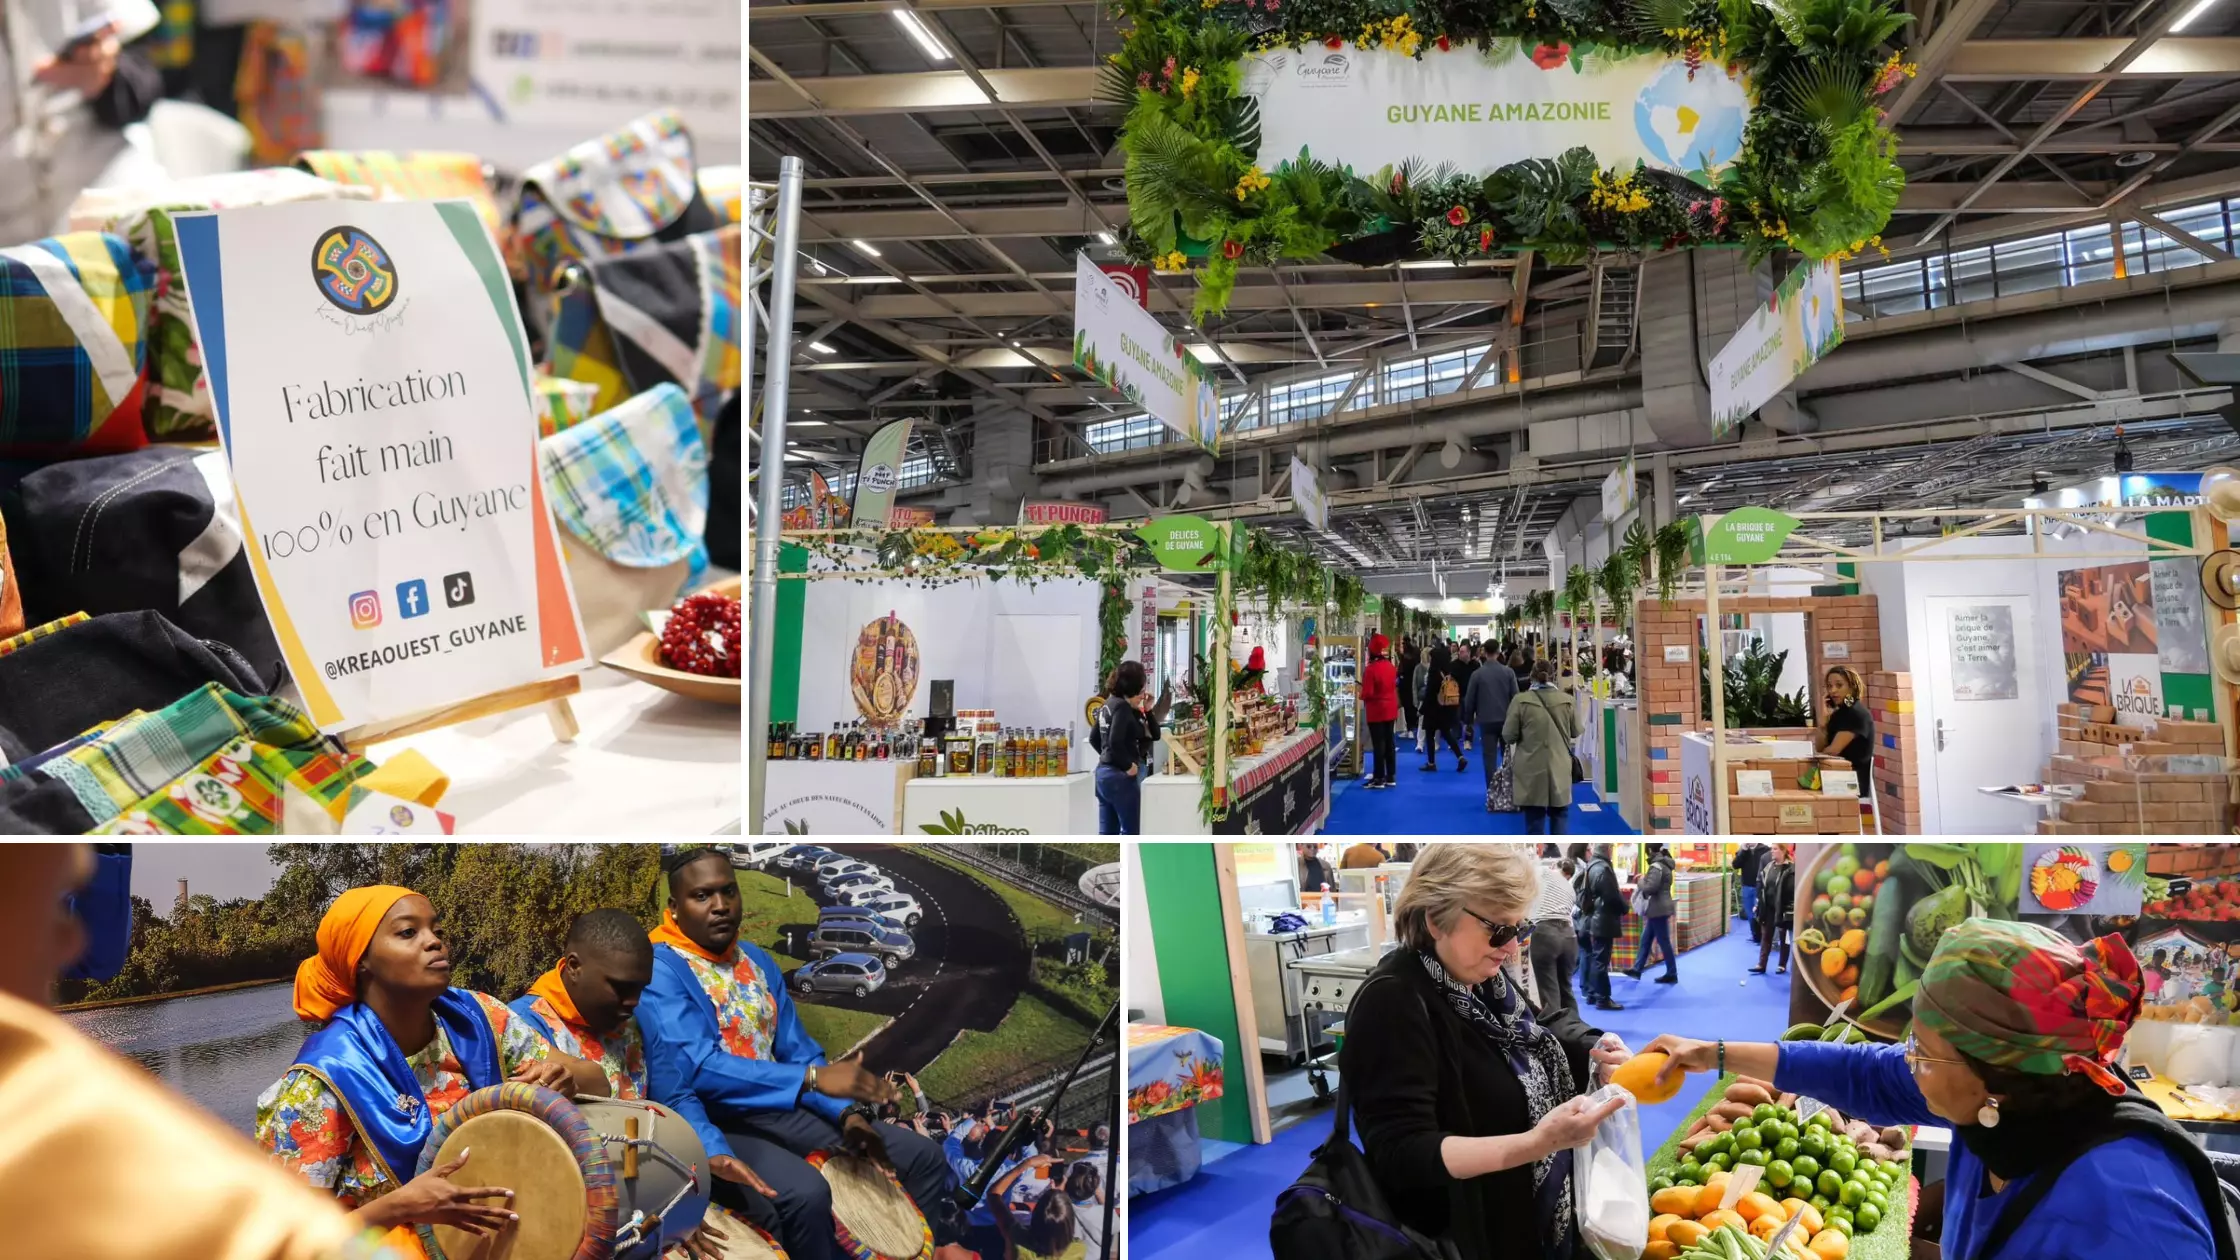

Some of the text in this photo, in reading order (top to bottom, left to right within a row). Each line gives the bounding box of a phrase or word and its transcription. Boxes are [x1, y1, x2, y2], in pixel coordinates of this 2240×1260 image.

[1387, 101, 1612, 124] GUYANE AMAZONIE
[1120, 332, 1185, 397] GUYANE AMAZONIE
[1730, 327, 1783, 390] GUYANE AMAZONIE
[282, 369, 467, 423] Fabrication
[316, 430, 453, 483] fait main
[263, 484, 528, 561] 100% en Guyane
[1725, 522, 1775, 532] LA BRIQUE DE
[1170, 530, 1199, 540] DELICES
[1736, 533, 1764, 543] GUYANE
[1165, 540, 1204, 551] DE GUYANE
[1955, 614, 1979, 622] Aimer
[1955, 623, 1993, 632] brique de
[325, 614, 527, 680] @KREAOUEST_GUYANE
[1956, 634, 1990, 643] Guyane,
[1957, 644, 2000, 652] c'est aimer
[1957, 654, 1988, 662] la Terre
[2121, 677, 2133, 695] LA
[2116, 694, 2160, 716] BRIQUE
[1685, 798, 1709, 835] BRIQUE
